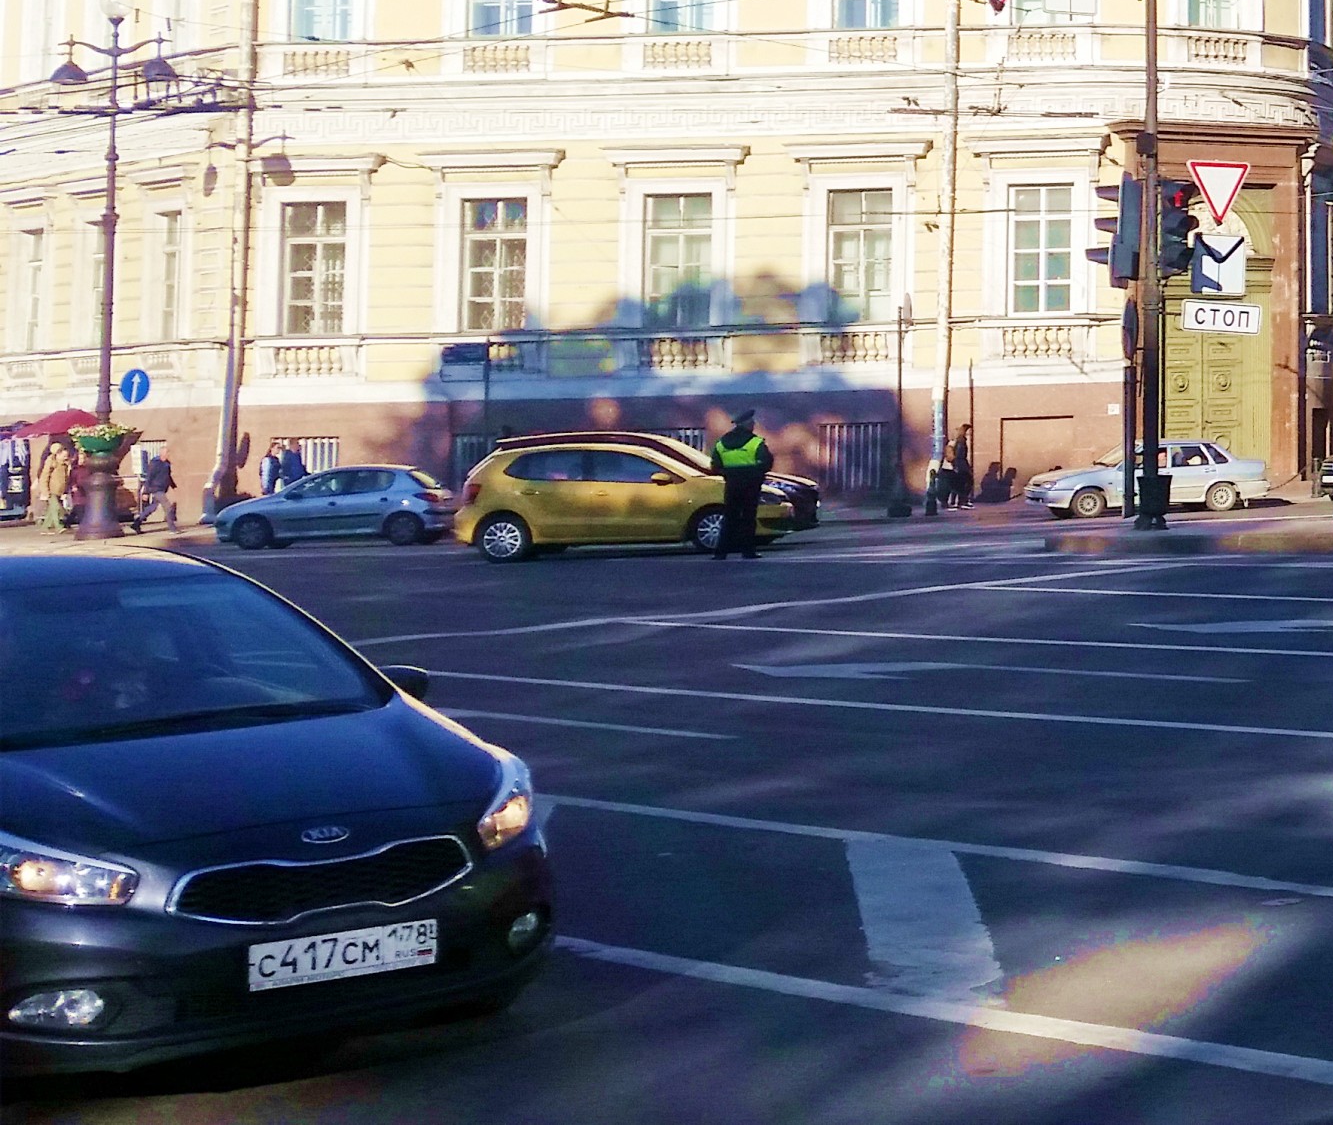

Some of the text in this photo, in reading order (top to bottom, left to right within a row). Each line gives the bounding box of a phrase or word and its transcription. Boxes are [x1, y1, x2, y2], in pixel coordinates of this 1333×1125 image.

[1194, 307, 1250, 329] СТОП
[257, 937, 380, 979] С417СМ
[387, 923, 428, 945] 178
[394, 948, 417, 959] RUS
